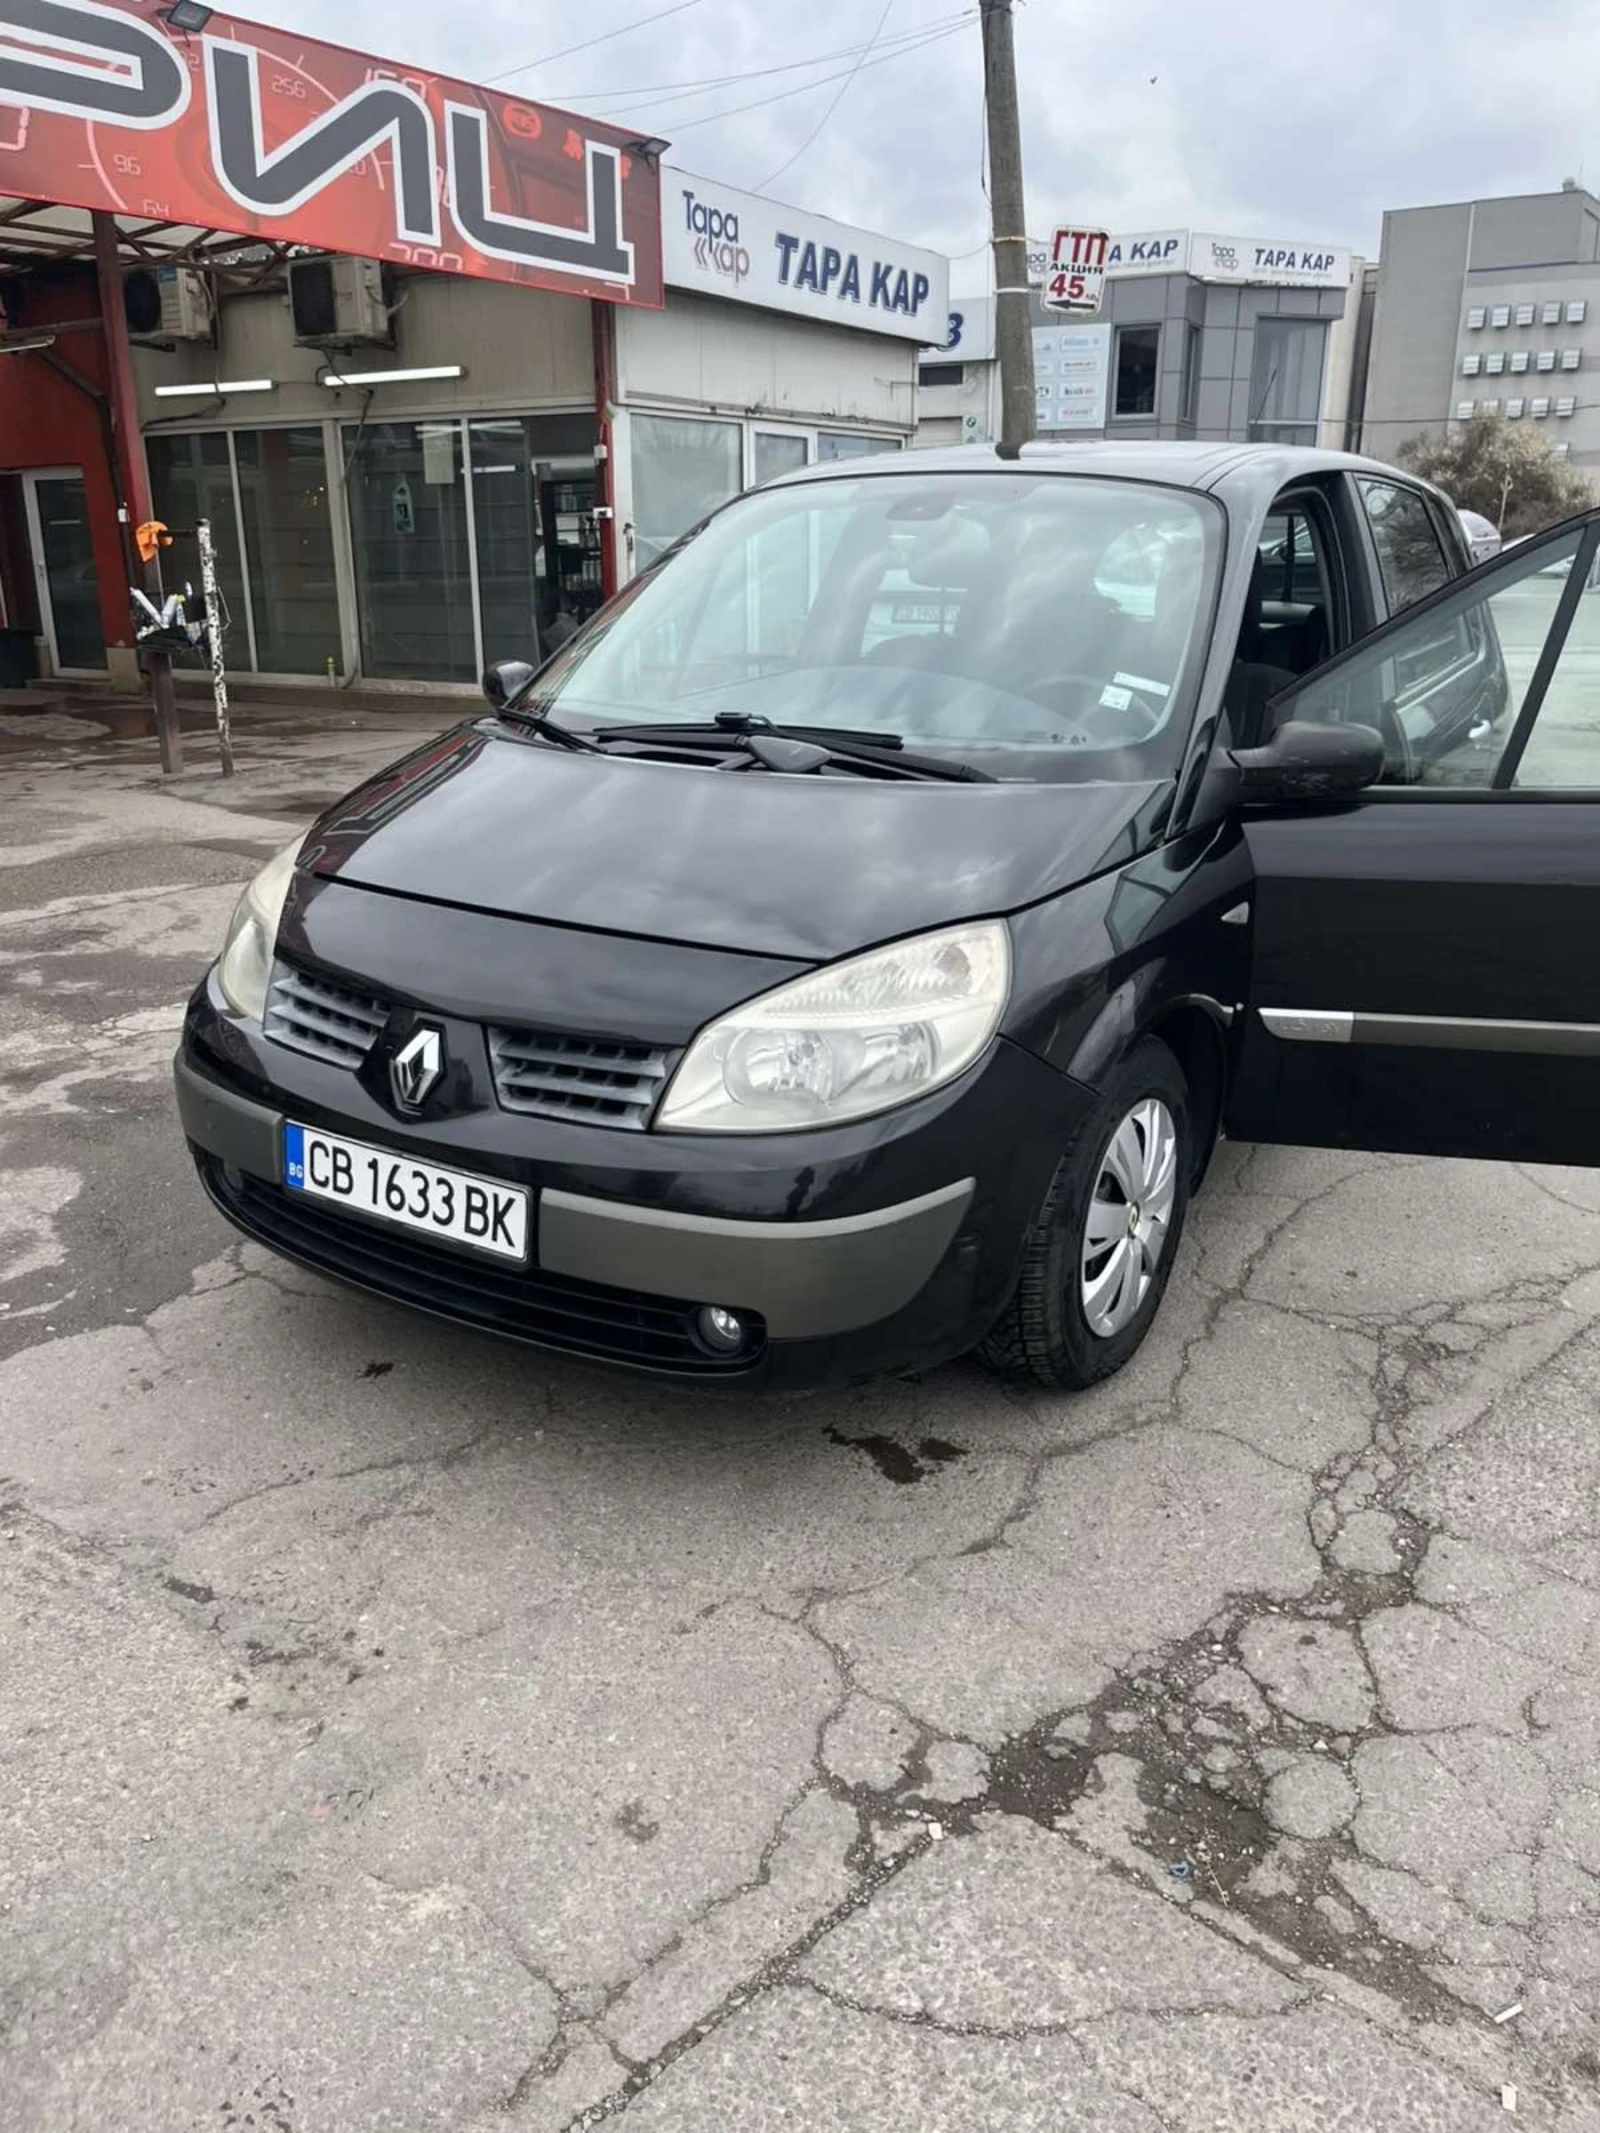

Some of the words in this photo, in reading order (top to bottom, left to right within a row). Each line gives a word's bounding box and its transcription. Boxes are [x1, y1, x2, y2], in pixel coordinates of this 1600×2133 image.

[113, 153, 141, 175] 96
[1053, 230, 1108, 265] ГТП
[1130, 239, 1179, 260] КАР
[1050, 263, 1104, 275] АКЦИЯ
[1254, 248, 1296, 269] ТАРА
[1300, 252, 1335, 271] КАР
[775, 232, 861, 304] ТАРА
[869, 261, 930, 316] КАР
[1049, 274, 1085, 299] 45
[288, 1162, 304, 1178] BG
[309, 1140, 354, 1195] CB
[367, 1157, 455, 1227] 1633
[464, 1184, 517, 1248] BK
